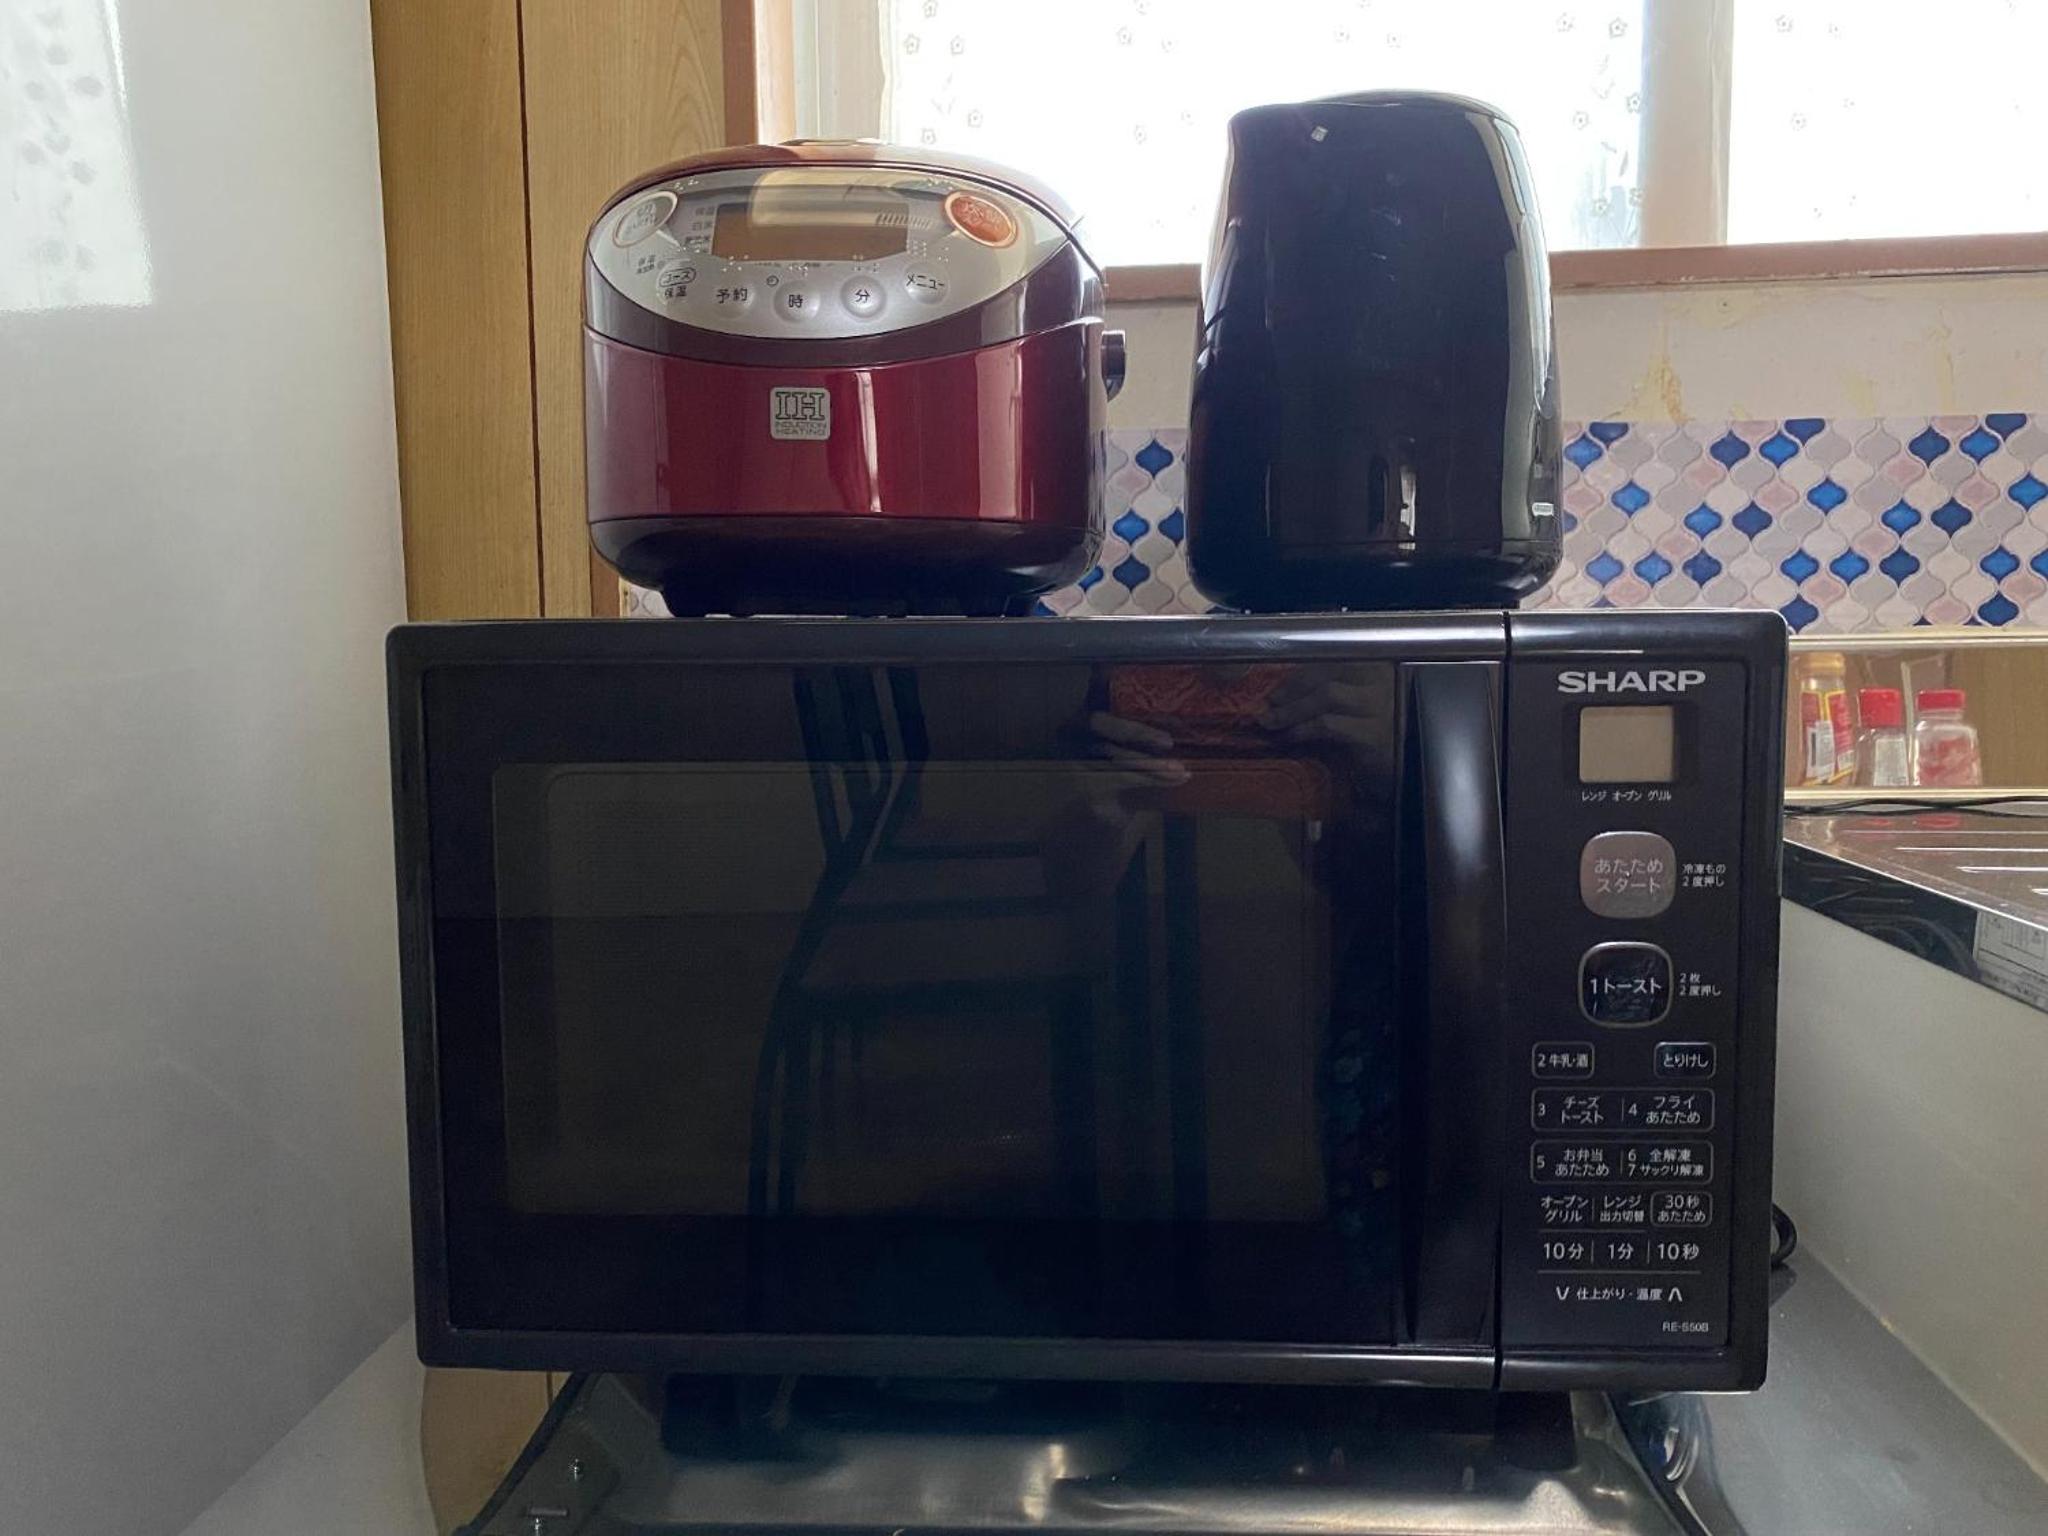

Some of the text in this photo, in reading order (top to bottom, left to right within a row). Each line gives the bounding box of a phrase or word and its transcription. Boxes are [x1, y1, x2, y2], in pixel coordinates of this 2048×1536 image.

[663, 271, 690, 284] コース
[906, 274, 945, 290] メニュー
[716, 288, 748, 304] 予約
[789, 294, 803, 308] 時
[855, 289, 870, 303] 分
[775, 391, 825, 420] IH
[1558, 671, 1706, 692] SHARP
[1582, 791, 1607, 801] レンジ
[1612, 790, 1641, 801] オーブン
[1648, 790, 1671, 801] グリル
[1595, 859, 1663, 874] あたため
[1598, 877, 1661, 892] スタート
[1663, 1055, 1708, 1068] とりけし
[1563, 1097, 1600, 1108] チーズ
[1654, 1097, 1694, 1108] フライ
[1561, 1112, 1604, 1124] トースト
[1646, 1112, 1700, 1124] あたため
[1563, 1149, 1603, 1161] お弁当
[1650, 1149, 1691, 1161] 全解凍
[1555, 1164, 1609, 1176] あたため
[1541, 1195, 1588, 1207] オーブン
[1604, 1195, 1641, 1207] レンジ
[1545, 1210, 1582, 1222] グリル
[1658, 1211, 1705, 1222] あたため
[1543, 1243, 1584, 1260] 10分
[1608, 1243, 1634, 1259] 1分
[1658, 1243, 1699, 1259] 10秒
